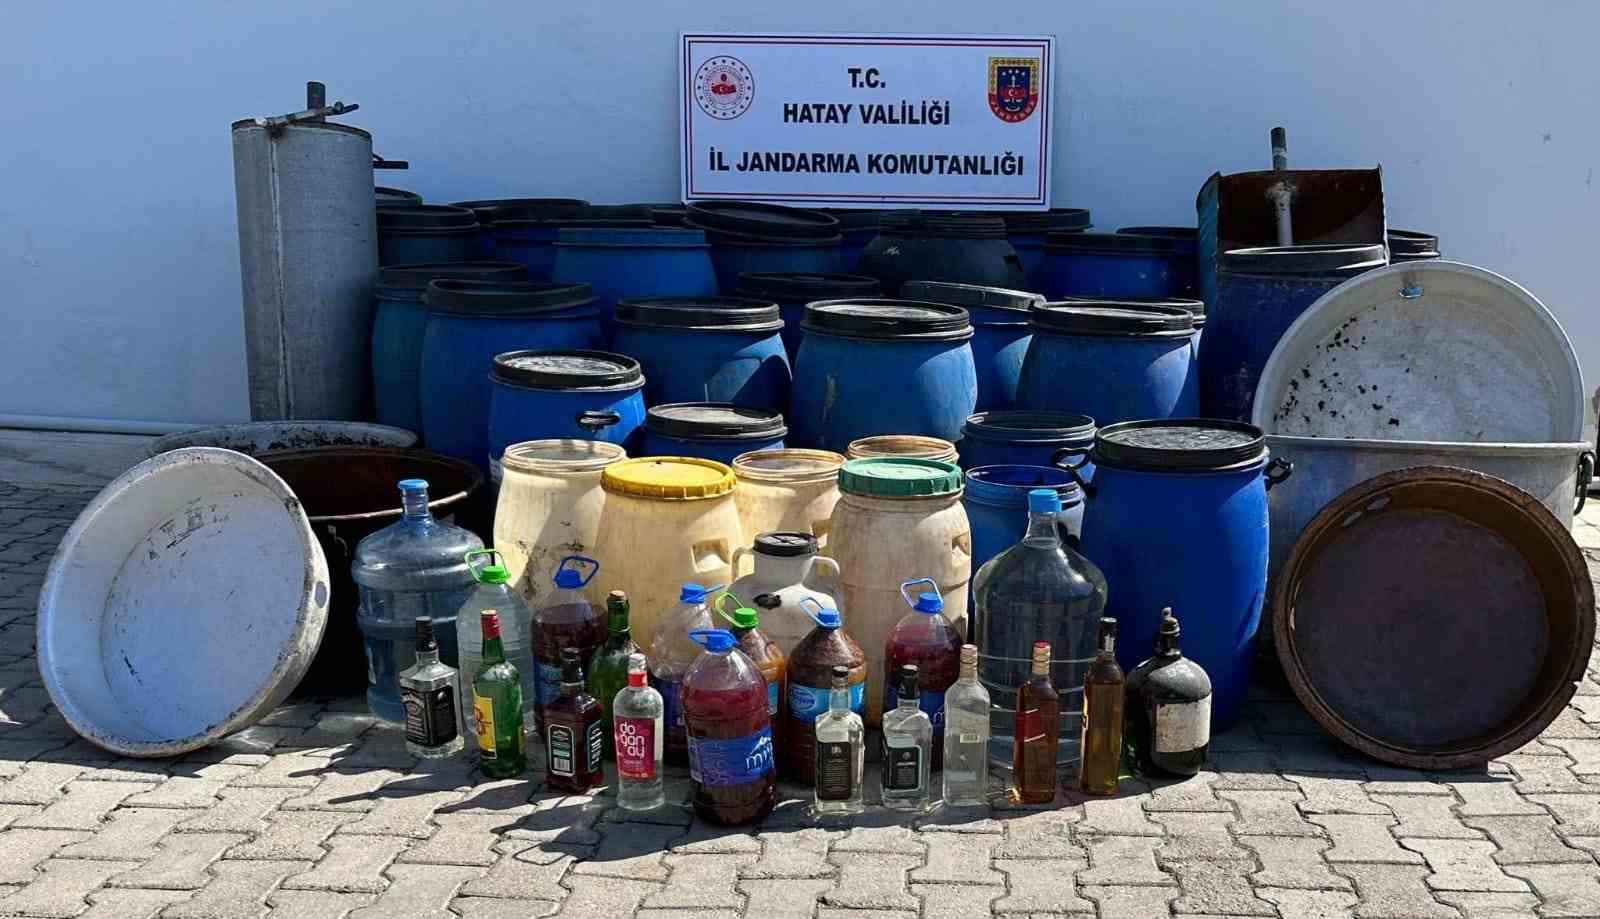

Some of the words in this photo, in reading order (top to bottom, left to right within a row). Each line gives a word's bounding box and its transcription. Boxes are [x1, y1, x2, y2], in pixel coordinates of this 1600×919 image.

[848, 67, 886, 88] T.C.
[783, 103, 853, 124] HATAY
[858, 99, 950, 126] VALİLİĞİ
[709, 146, 730, 171] İL
[736, 151, 860, 174] JANDARMA
[867, 150, 1024, 176] KOMUTANLIĞI
